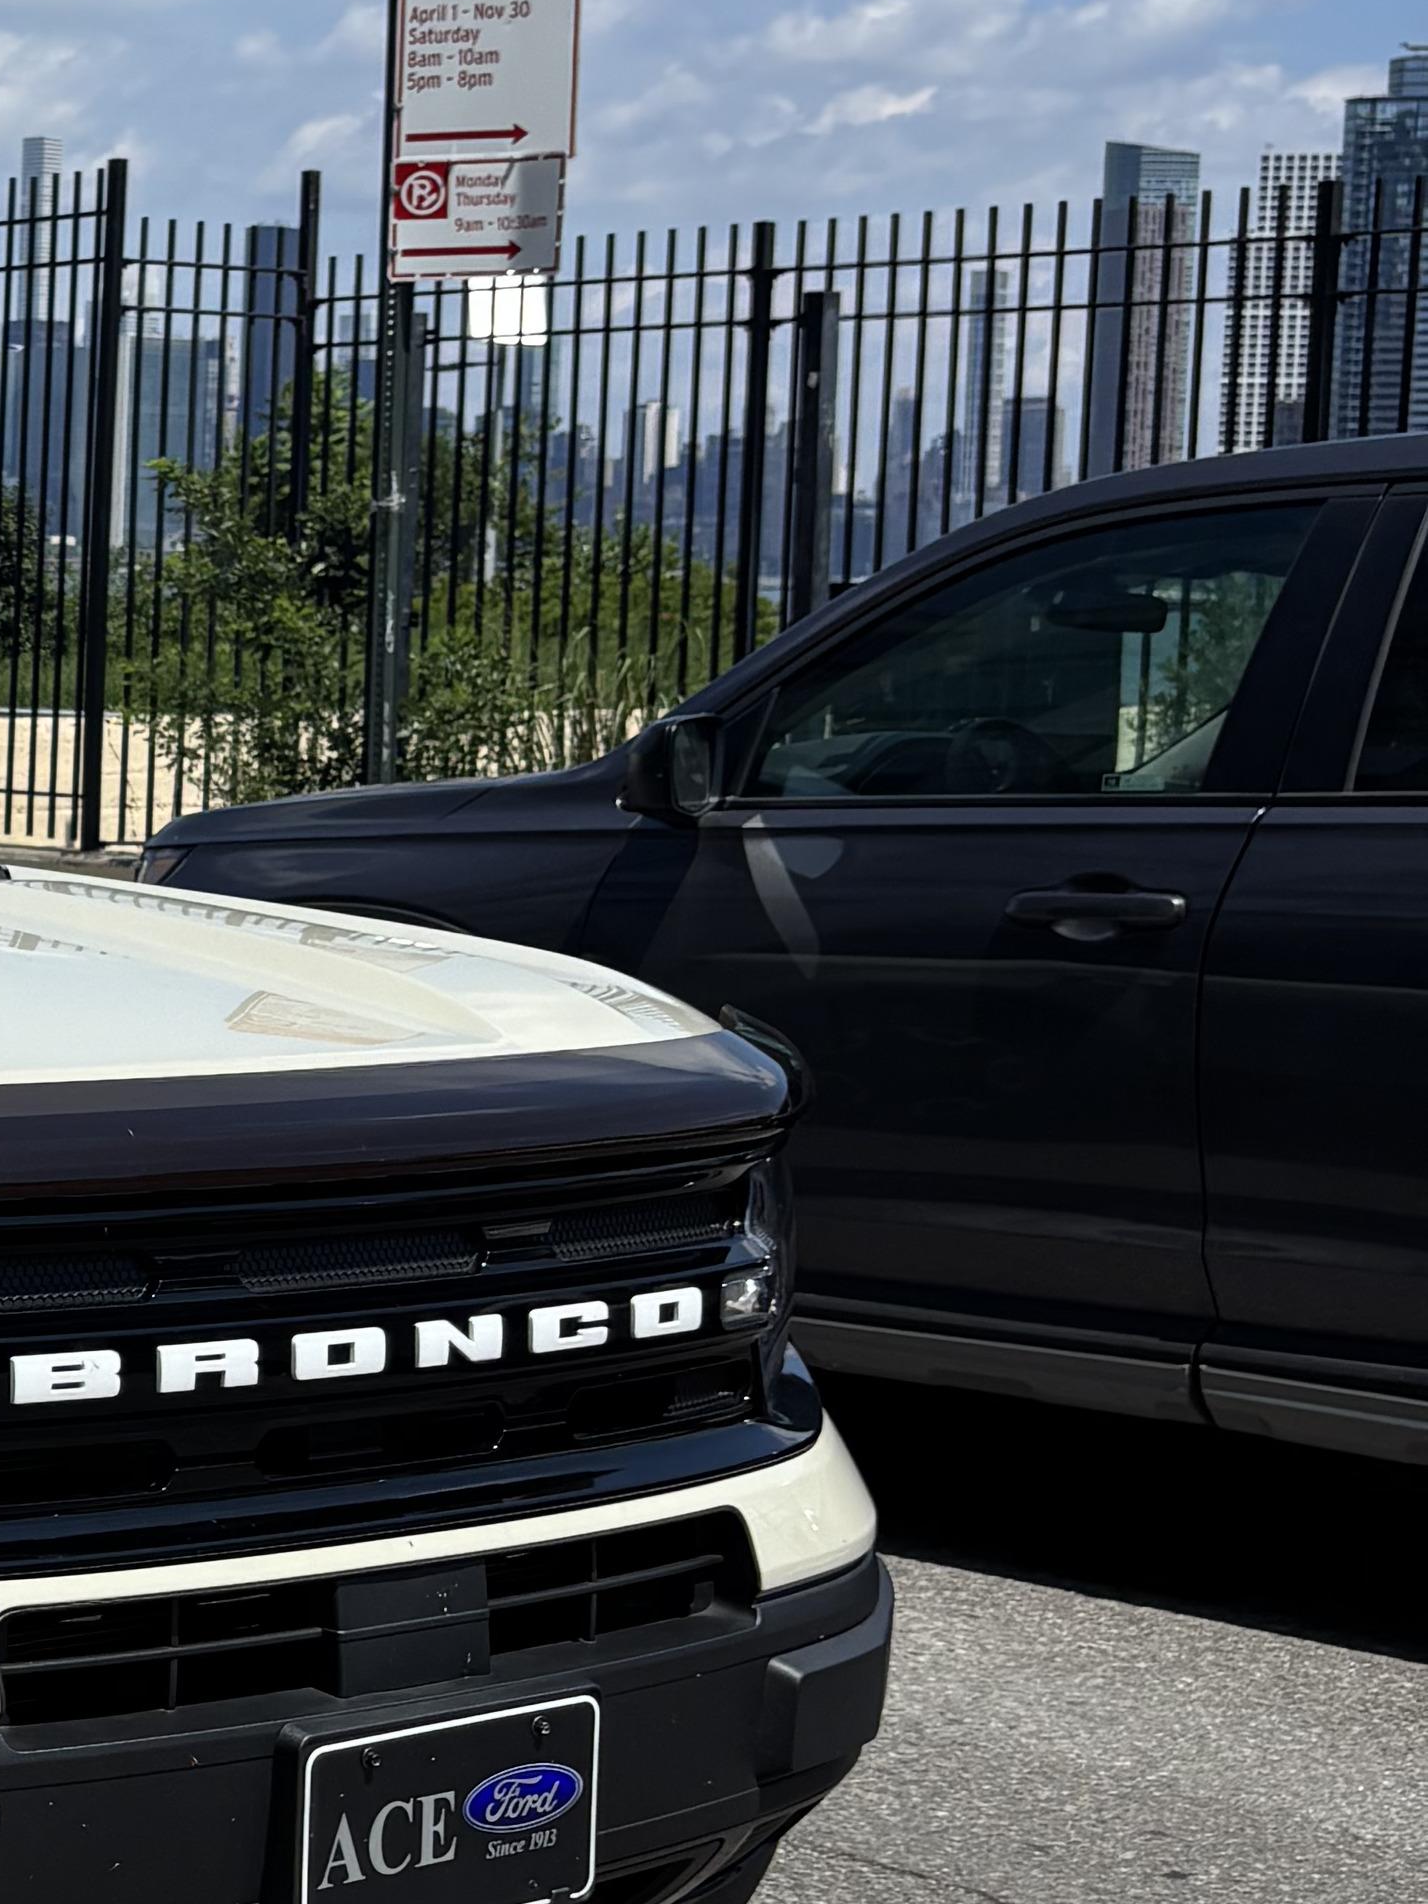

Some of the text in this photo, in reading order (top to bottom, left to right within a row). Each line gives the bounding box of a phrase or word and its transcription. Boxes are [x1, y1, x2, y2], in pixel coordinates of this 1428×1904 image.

[409, 4, 446, 25] April
[451, 4, 459, 21] 1
[473, 3, 505, 21] Nov
[509, 0, 531, 19] 30
[408, 27, 481, 46] Saturday
[407, 51, 442, 68] 8am
[459, 48, 501, 66] 10am
[407, 72, 441, 93] 5pm
[457, 70, 493, 91] 8pm
[455, 174, 505, 189] Monday
[455, 192, 517, 209] Thursday
[454, 217, 484, 233] 9am
[497, 214, 548, 231] 10:30am
[10, 1287, 703, 1404] BRONCO
[316, 1775, 560, 1890] ACE Ford
[486, 1828, 557, 1860] Since 1913
